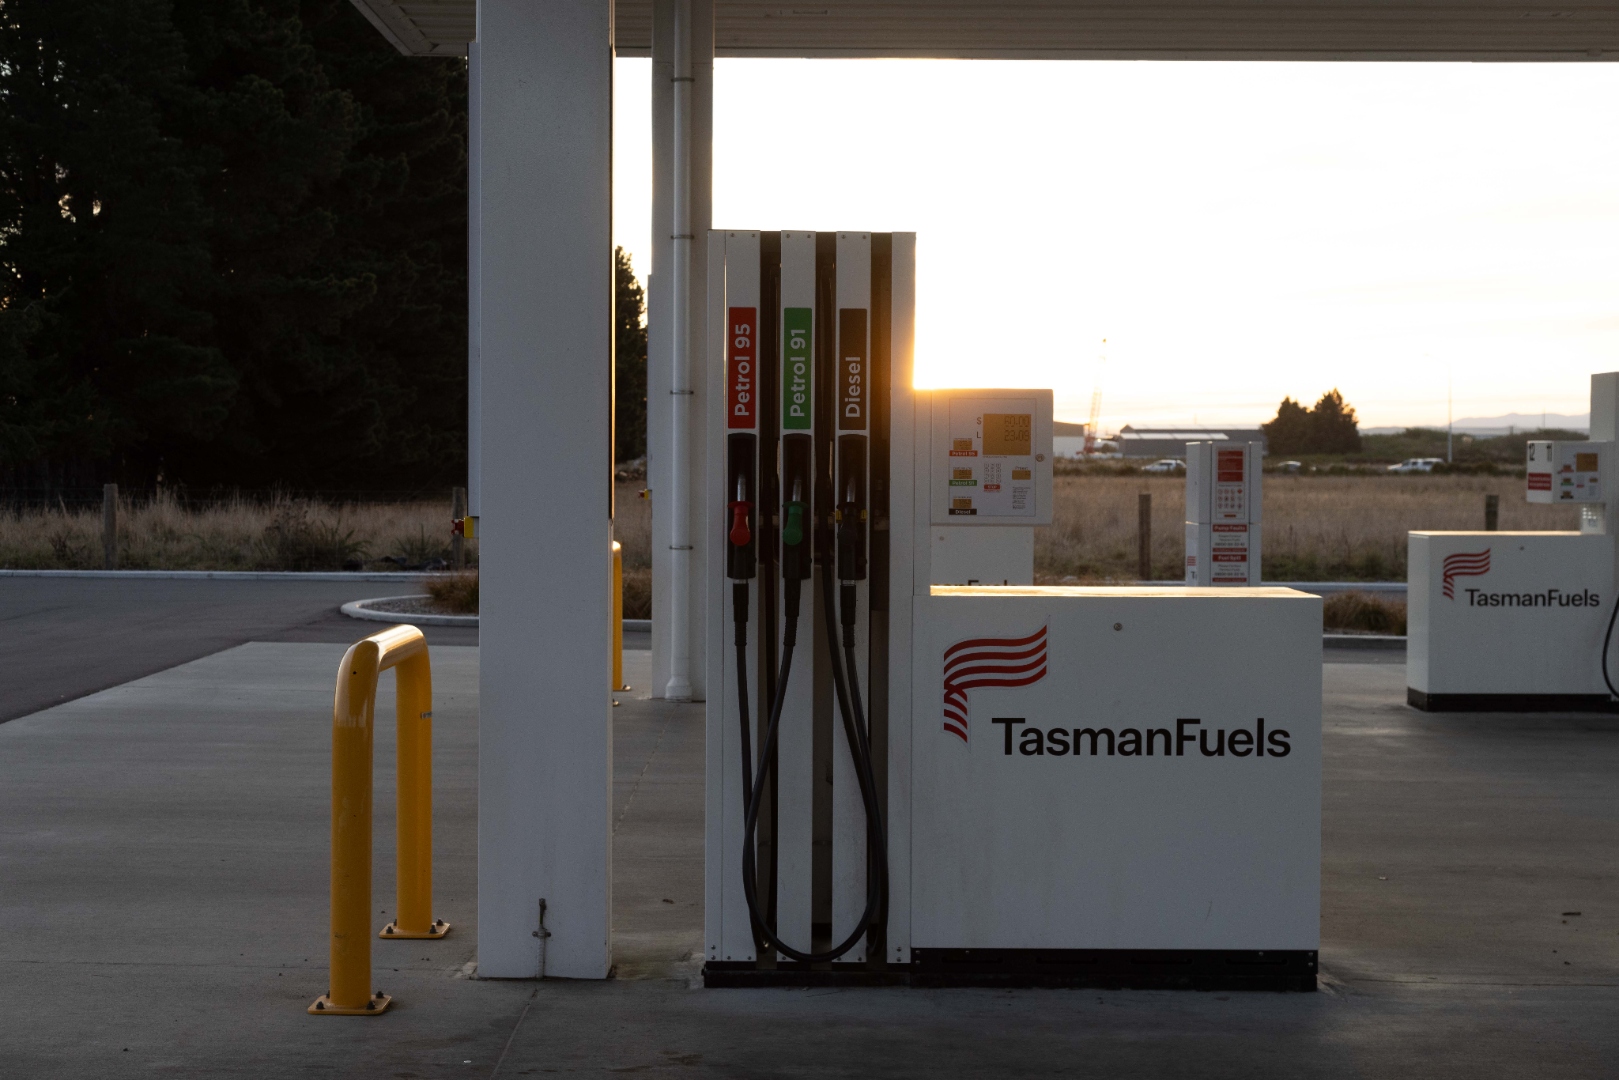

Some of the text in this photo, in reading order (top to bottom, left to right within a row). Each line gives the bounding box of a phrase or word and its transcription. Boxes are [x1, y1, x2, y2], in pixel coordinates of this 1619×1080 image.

[734, 323, 751, 416] Petrol 95
[790, 329, 806, 417] Petrol 91
[844, 356, 861, 418] Diesel
[1464, 588, 1601, 607] TasmanFuels
[991, 717, 1292, 758] TasmanFuels
